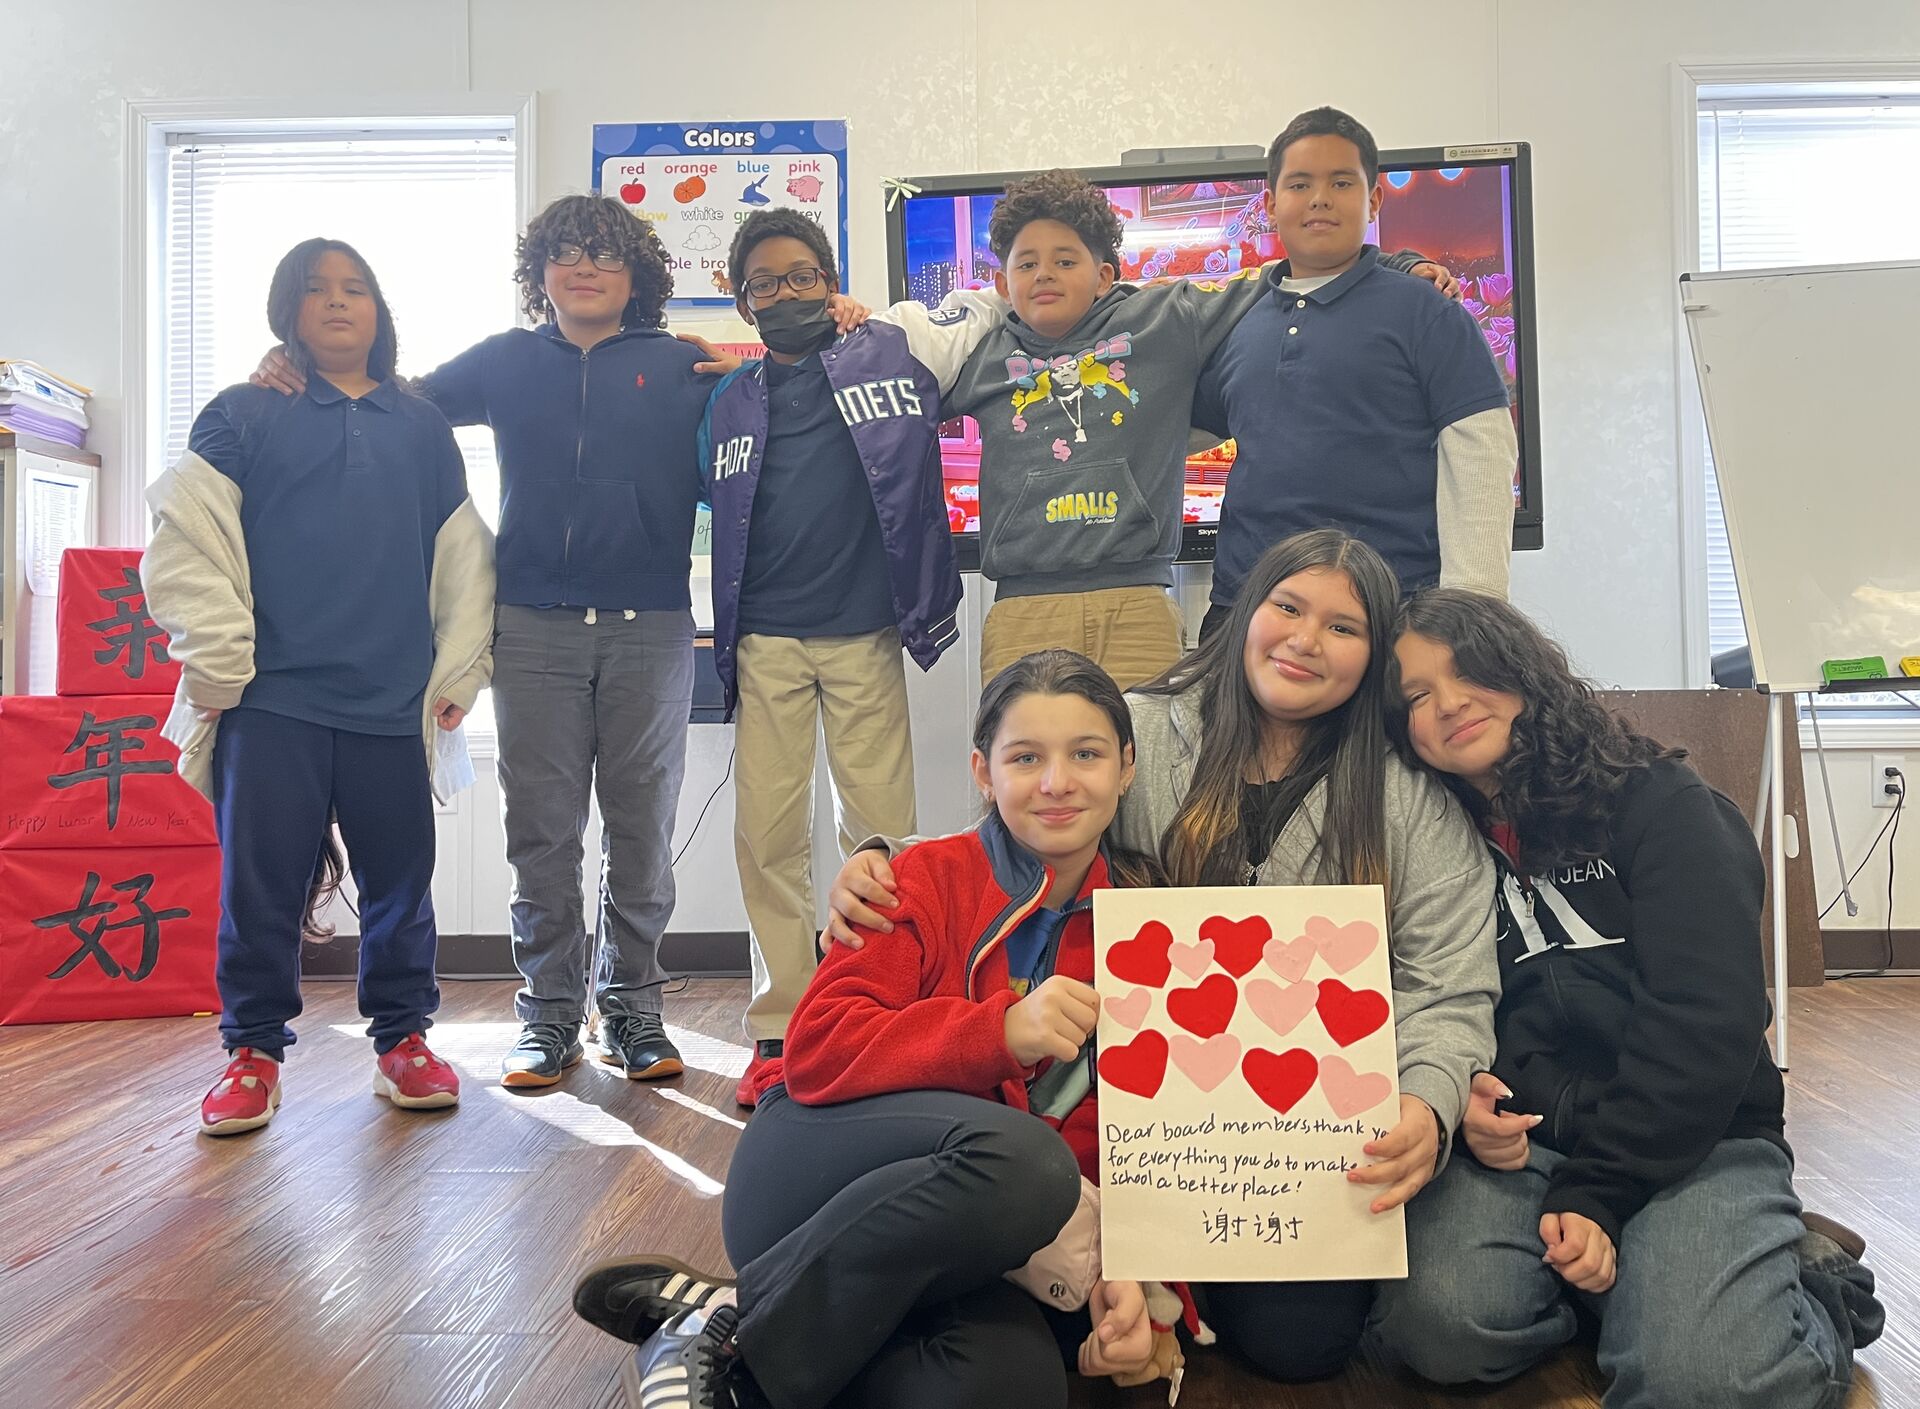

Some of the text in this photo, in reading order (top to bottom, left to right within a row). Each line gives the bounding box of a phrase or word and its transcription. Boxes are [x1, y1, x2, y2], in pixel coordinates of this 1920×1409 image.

[684, 128, 756, 148] Colors
[620, 162, 645, 175] red
[664, 163, 718, 176] orange
[737, 161, 770, 174] blue
[788, 160, 821, 176] pink
[681, 207, 724, 221] white
[669, 257, 692, 272] ple
[700, 256, 726, 269] bro
[1046, 491, 1118, 523] SMALLS
[47, 711, 174, 831] 年
[58, 816, 95, 828] Lunar
[128, 816, 157, 828] New
[167, 810, 196, 831] Year
[30, 872, 192, 982] 好
[1106, 1122, 1155, 1143] Dear
[1163, 1113, 1216, 1141] board
[1372, 1127, 1390, 1141] yo
[1108, 1145, 1134, 1168] for
[1138, 1147, 1227, 1175] everything
[1234, 1155, 1261, 1174] you
[1264, 1151, 1280, 1169] do
[1285, 1155, 1299, 1172] to
[1110, 1169, 1303, 1202] school a better place!
[1202, 1206, 1304, 1245] 谢谢
